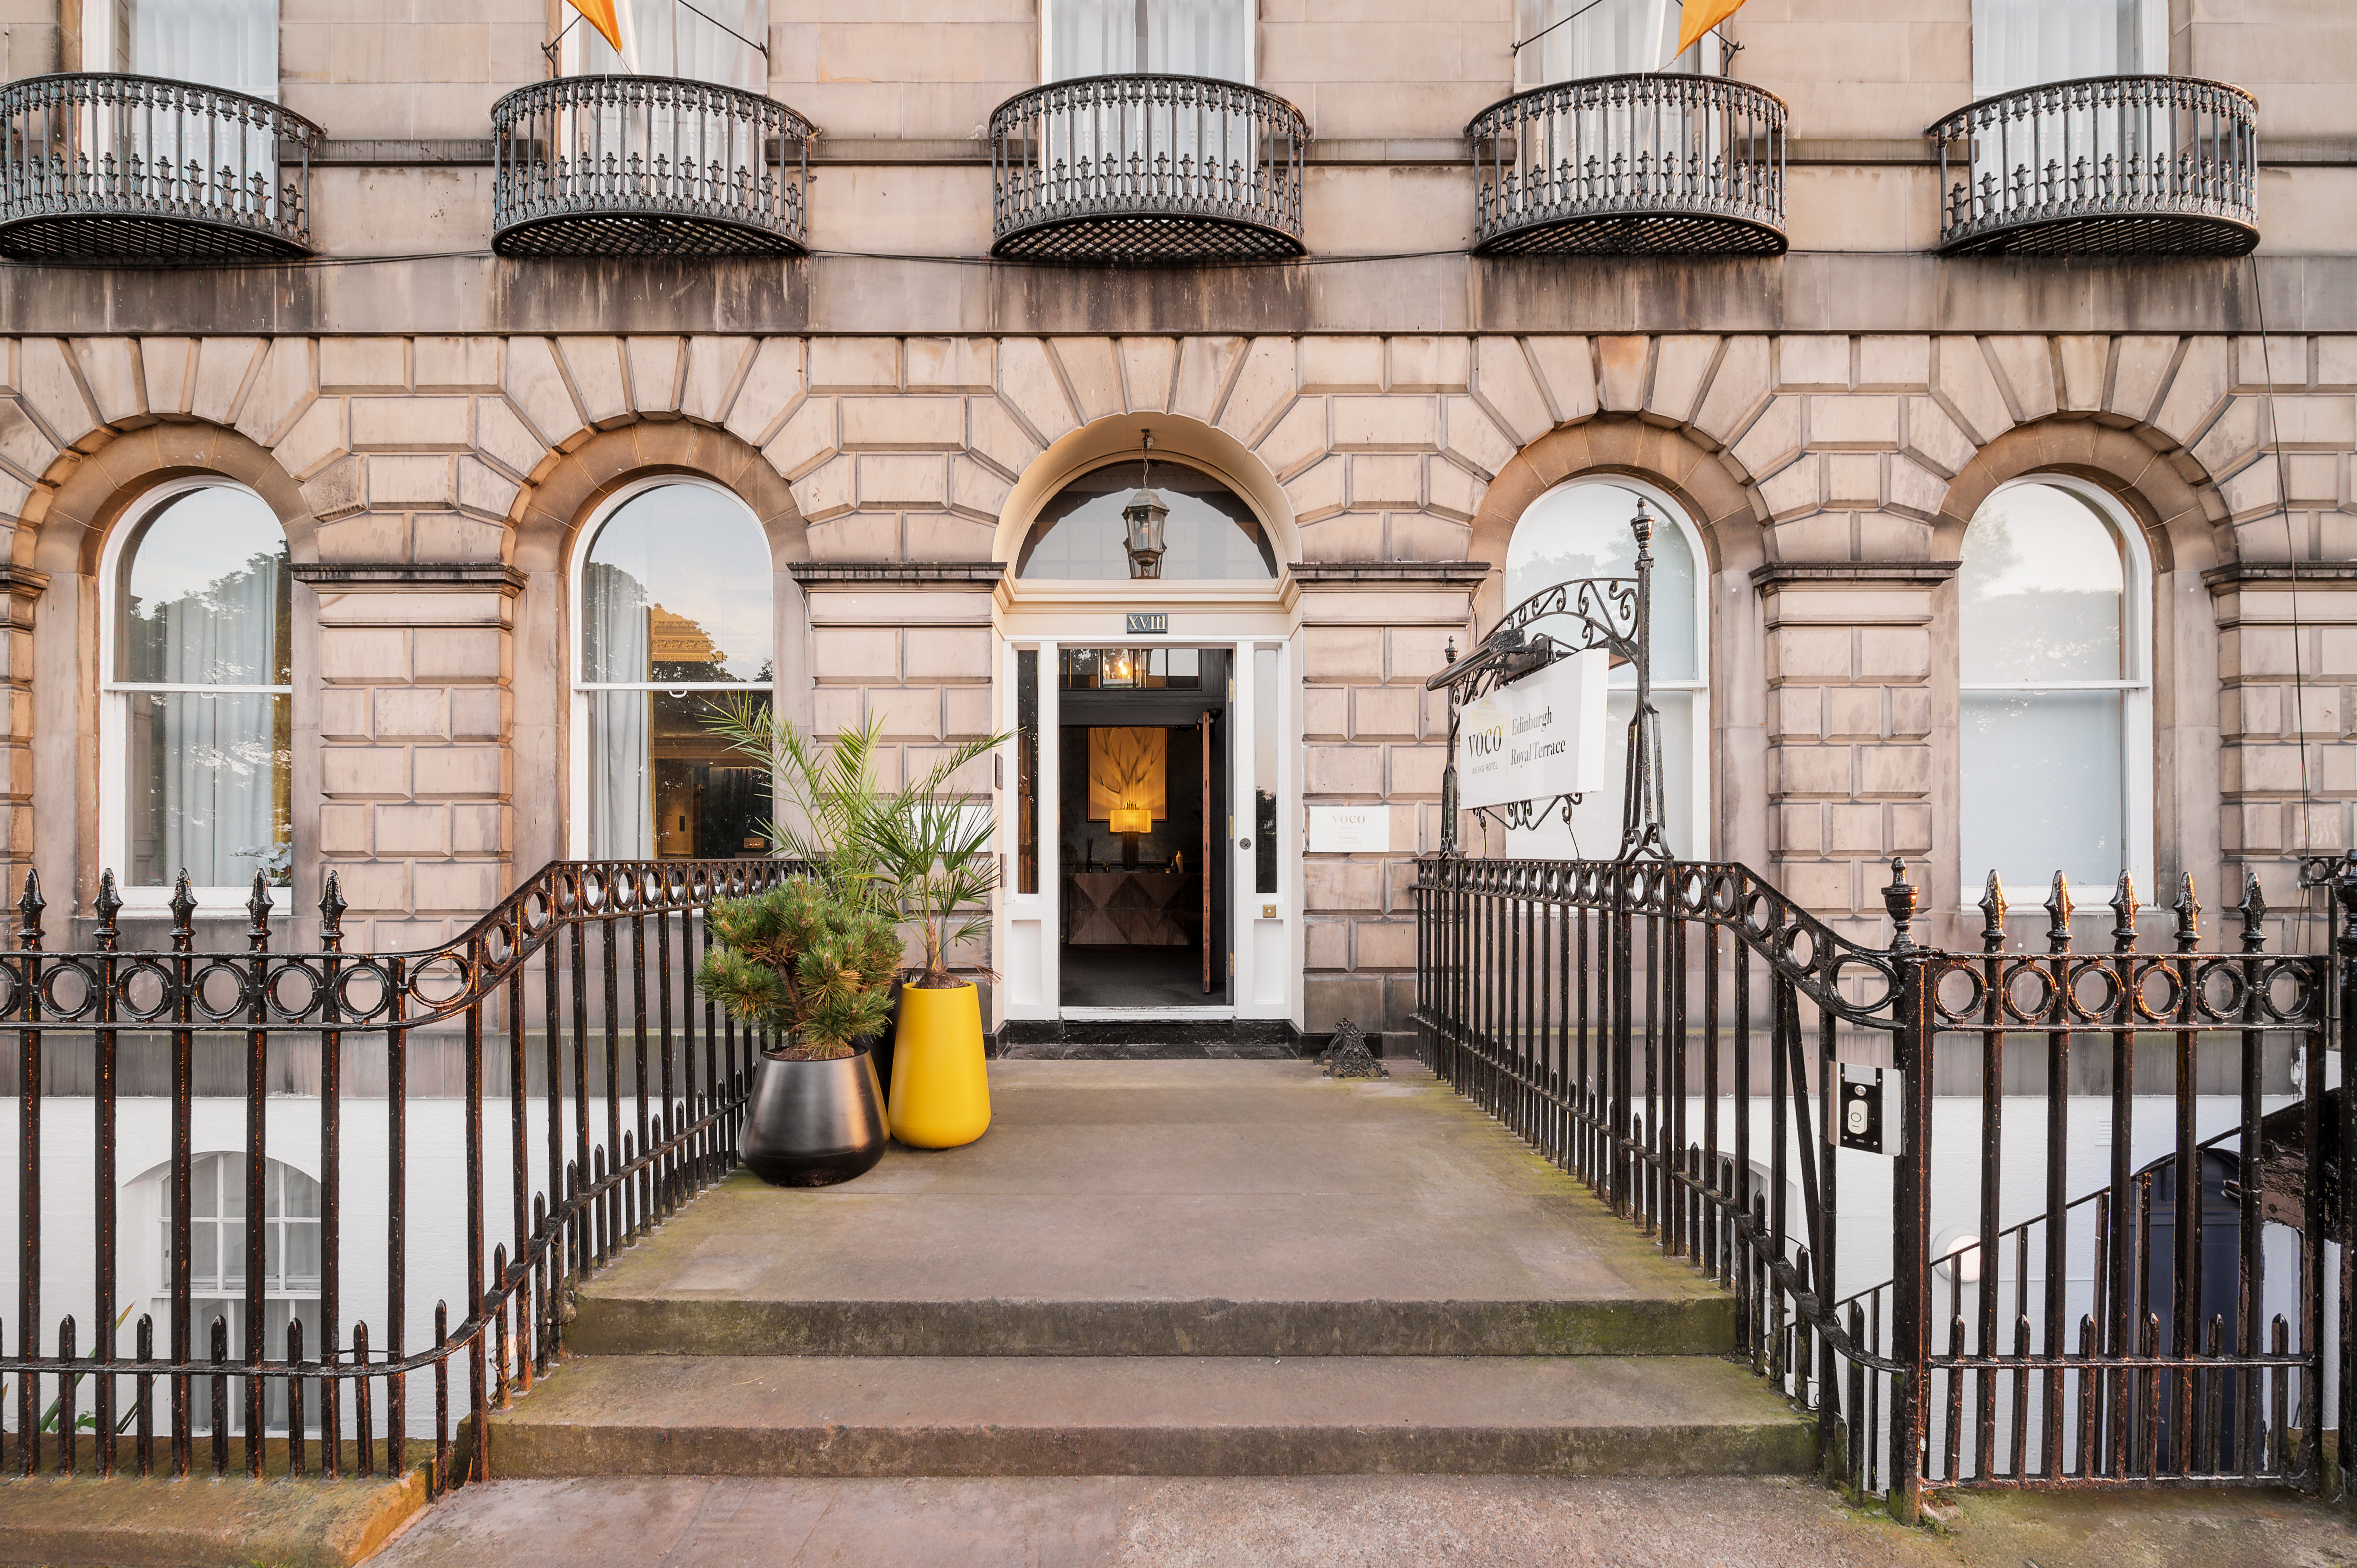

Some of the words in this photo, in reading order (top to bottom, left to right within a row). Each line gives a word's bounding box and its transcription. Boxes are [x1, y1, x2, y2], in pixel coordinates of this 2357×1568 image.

[1128, 616, 1166, 630] XVIII
[1512, 706, 1552, 736] Edinburgh
[1511, 743, 1531, 768] Royal
[1533, 740, 1566, 759] Terrace
[1472, 766, 1477, 775] AN
[1485, 762, 1498, 772] HOTEL
